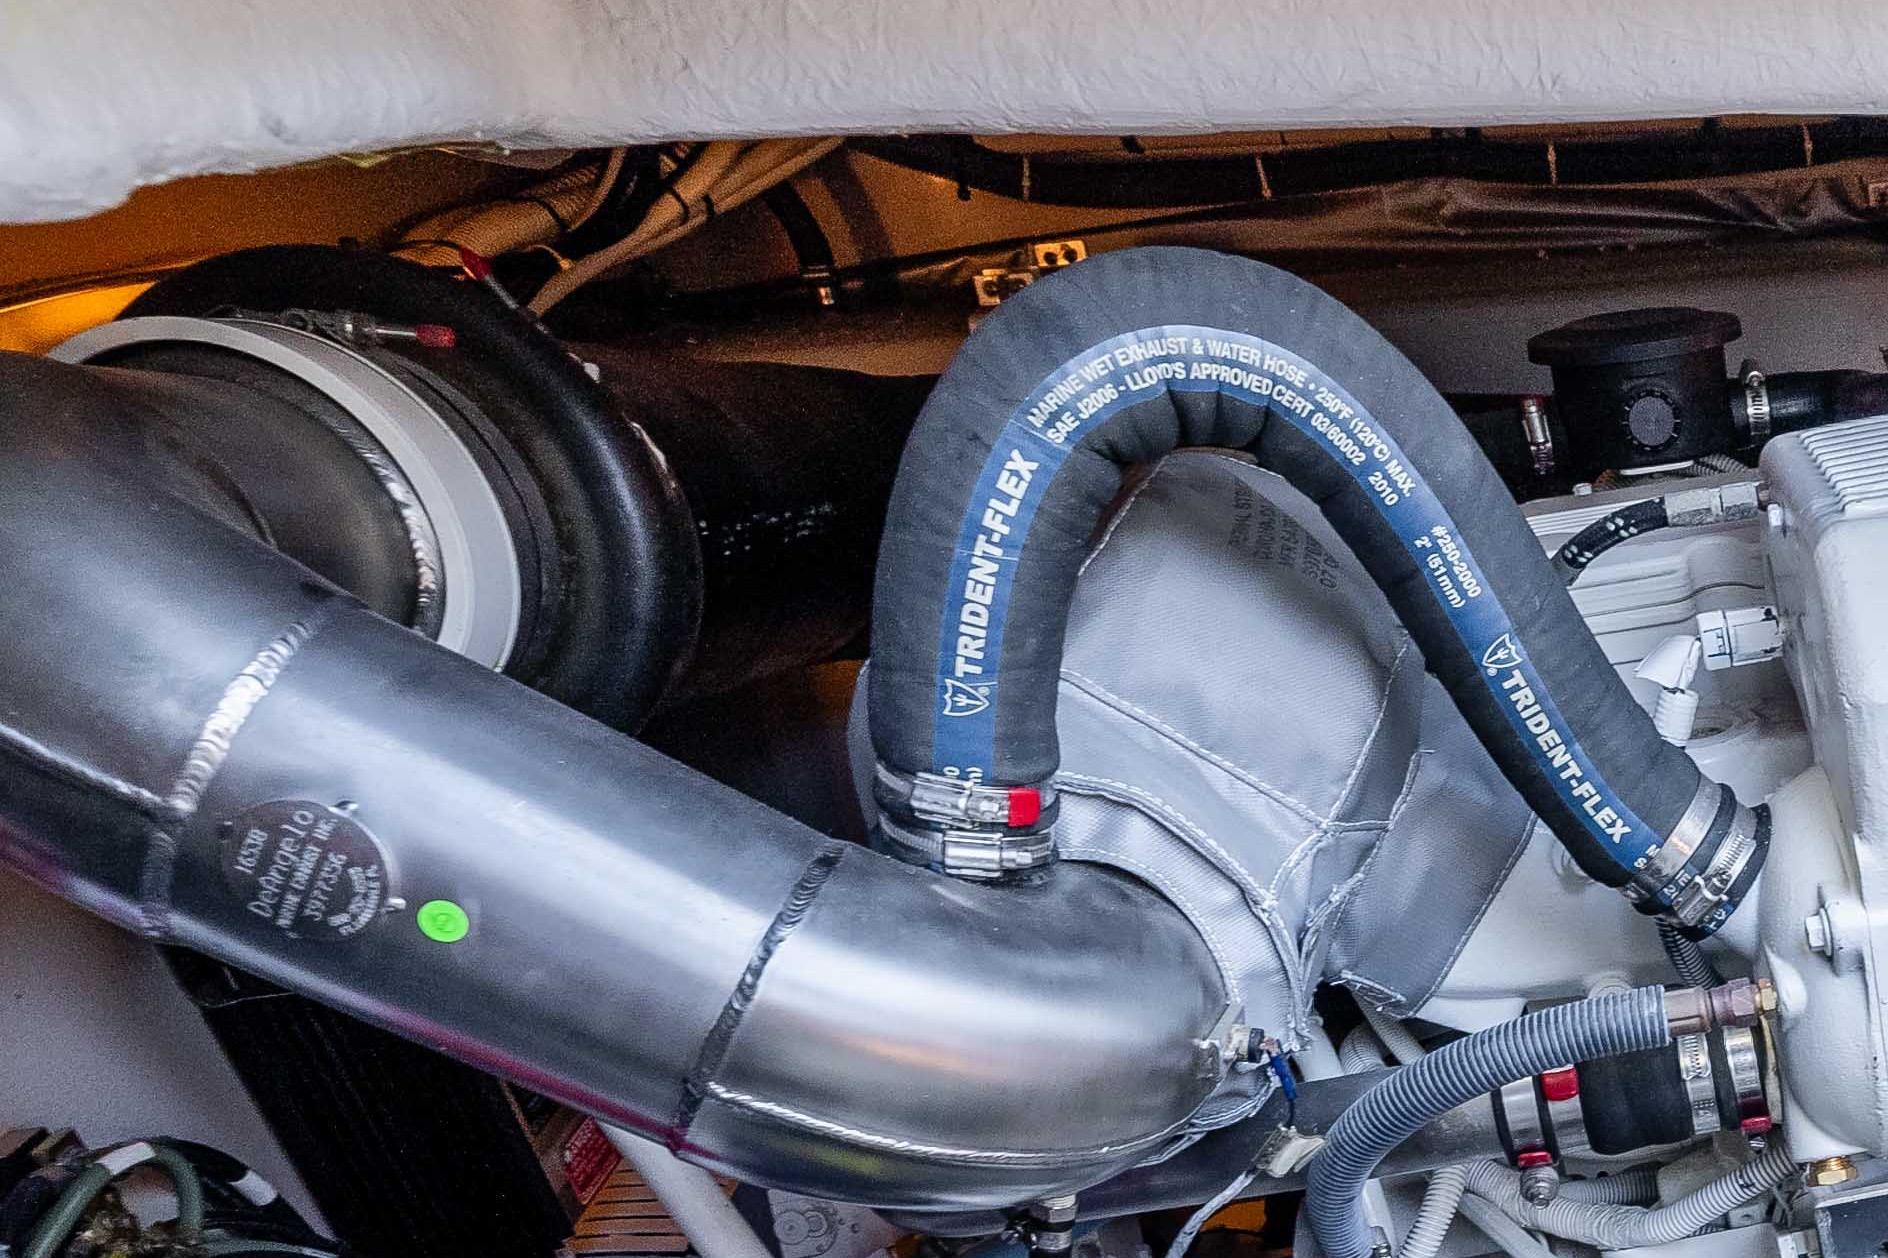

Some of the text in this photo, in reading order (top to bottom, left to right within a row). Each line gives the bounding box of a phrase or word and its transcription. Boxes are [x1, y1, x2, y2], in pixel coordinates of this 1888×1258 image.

[1027, 374, 1083, 428] MARINE
[1079, 354, 1116, 384] WET
[1115, 337, 1188, 367] EXHAUST
[1192, 337, 1205, 356] &
[1207, 339, 1261, 367] WATER
[1263, 354, 1309, 388] HOSE
[1046, 412, 1079, 445] SAE
[1077, 382, 1119, 420] J2006
[1124, 361, 1187, 392] LLOYD'S
[1190, 362, 1272, 396] APPROVED
[1271, 384, 1314, 418] CERT
[1368, 471, 1400, 507] 2010
[955, 449, 1039, 677] TRIDENT-FLEX
[1501, 668, 1632, 844] TRIDENT-FLEX
[246, 809, 315, 918] DeAngelo
